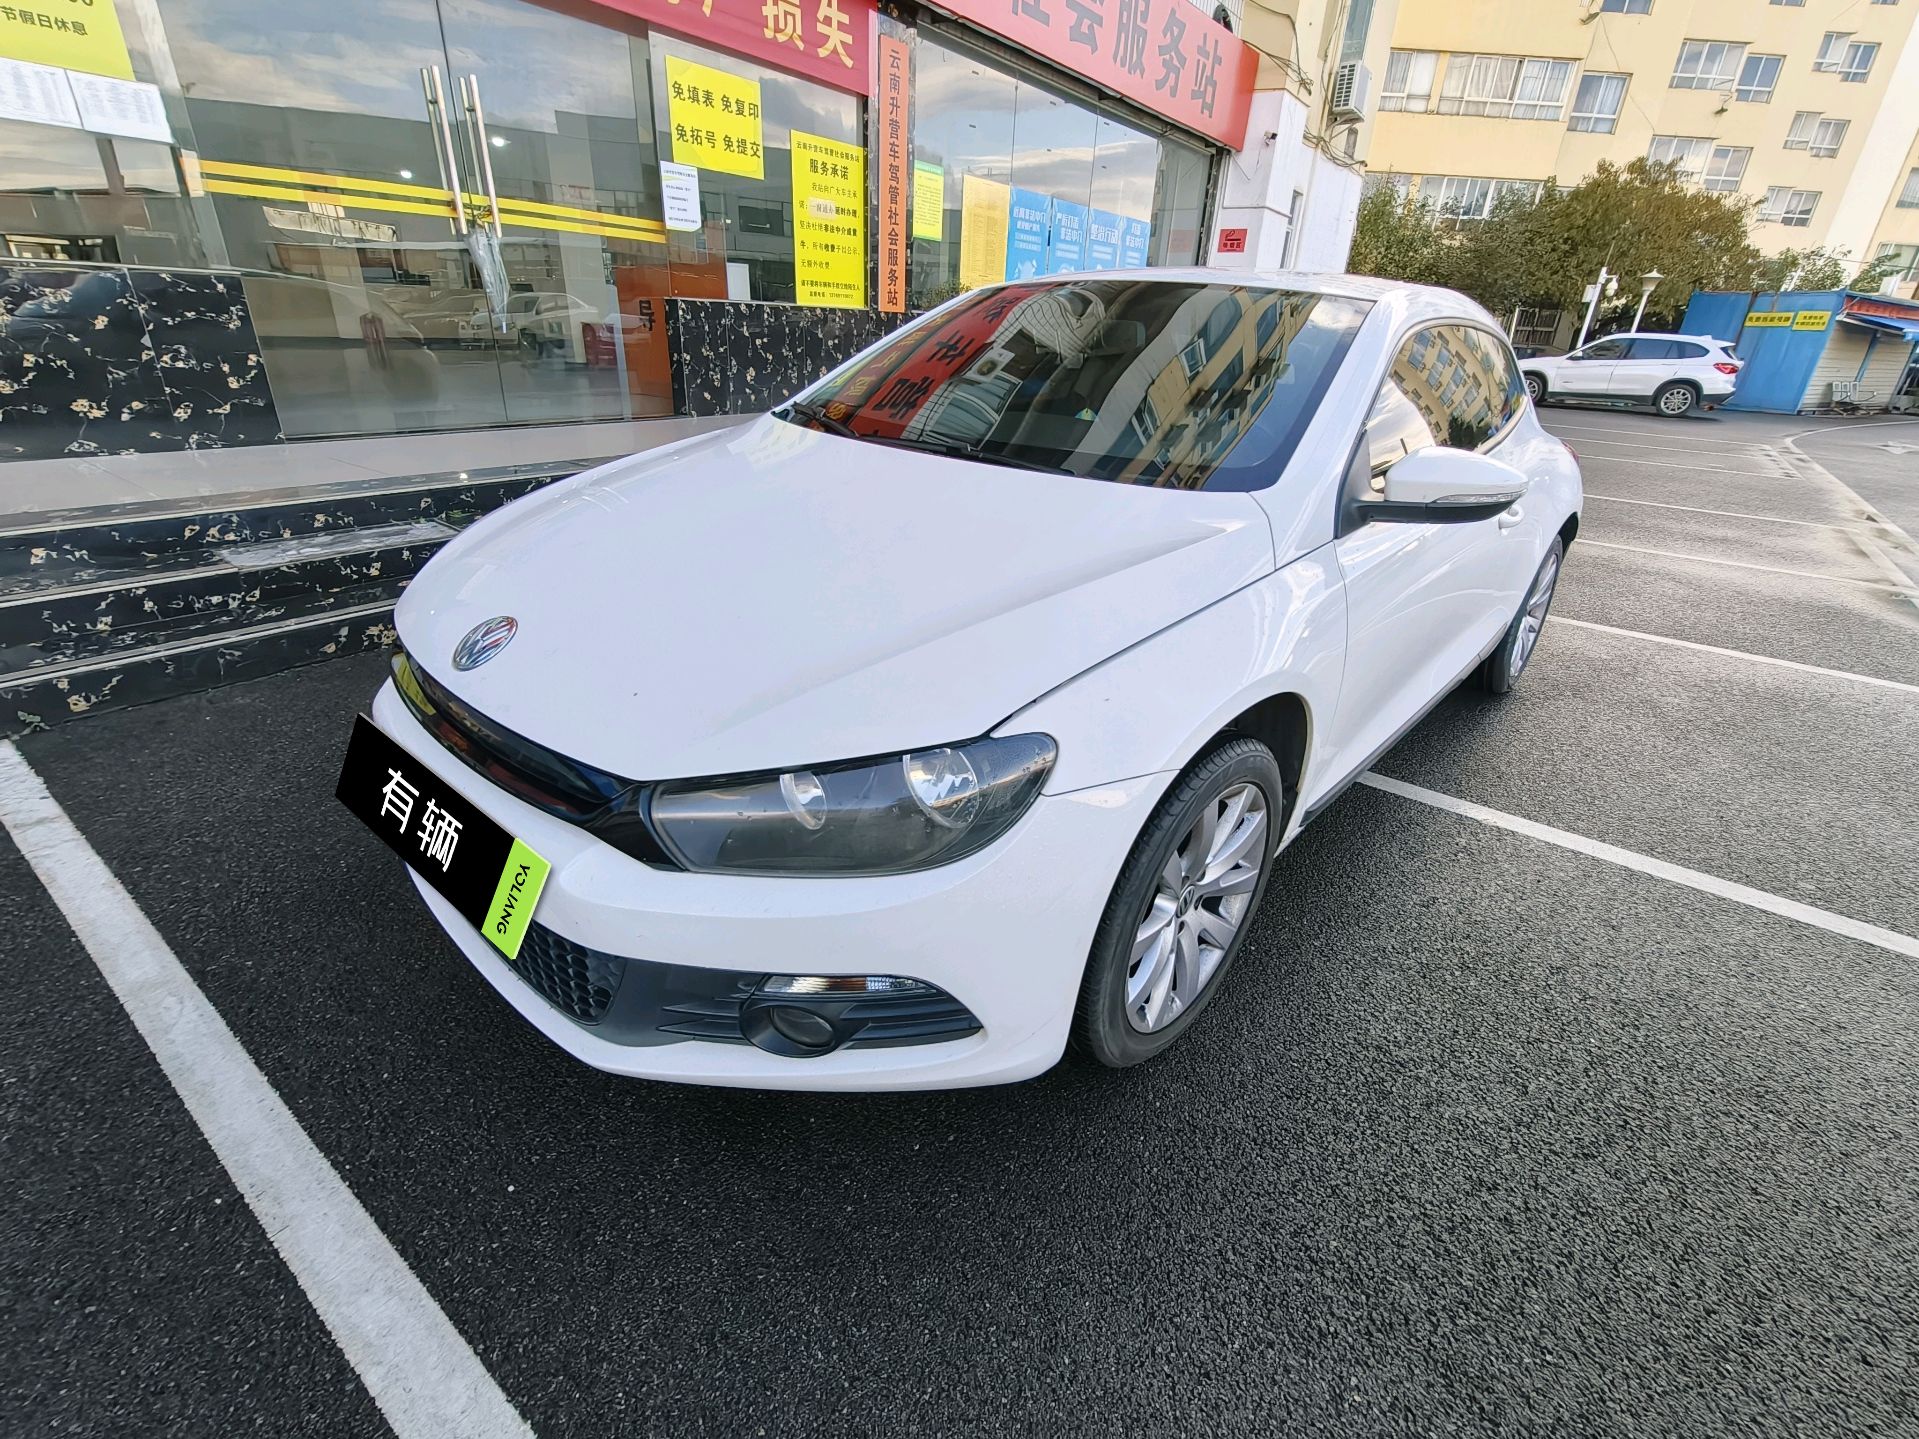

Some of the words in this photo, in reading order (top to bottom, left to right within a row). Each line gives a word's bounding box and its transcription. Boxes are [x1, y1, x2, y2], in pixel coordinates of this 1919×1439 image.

[0, 6, 88, 36] 节假日休息
[701, 0, 855, 69] 损失
[672, 80, 714, 109] 免填表
[721, 94, 759, 120] 免复印
[675, 123, 717, 149] 免拓号
[723, 134, 760, 159] 免提交
[809, 158, 849, 180] 服务承诺
[887, 48, 902, 307] 云南升营车驾管社会服务站
[811, 182, 858, 199] 我站向广大车主承
